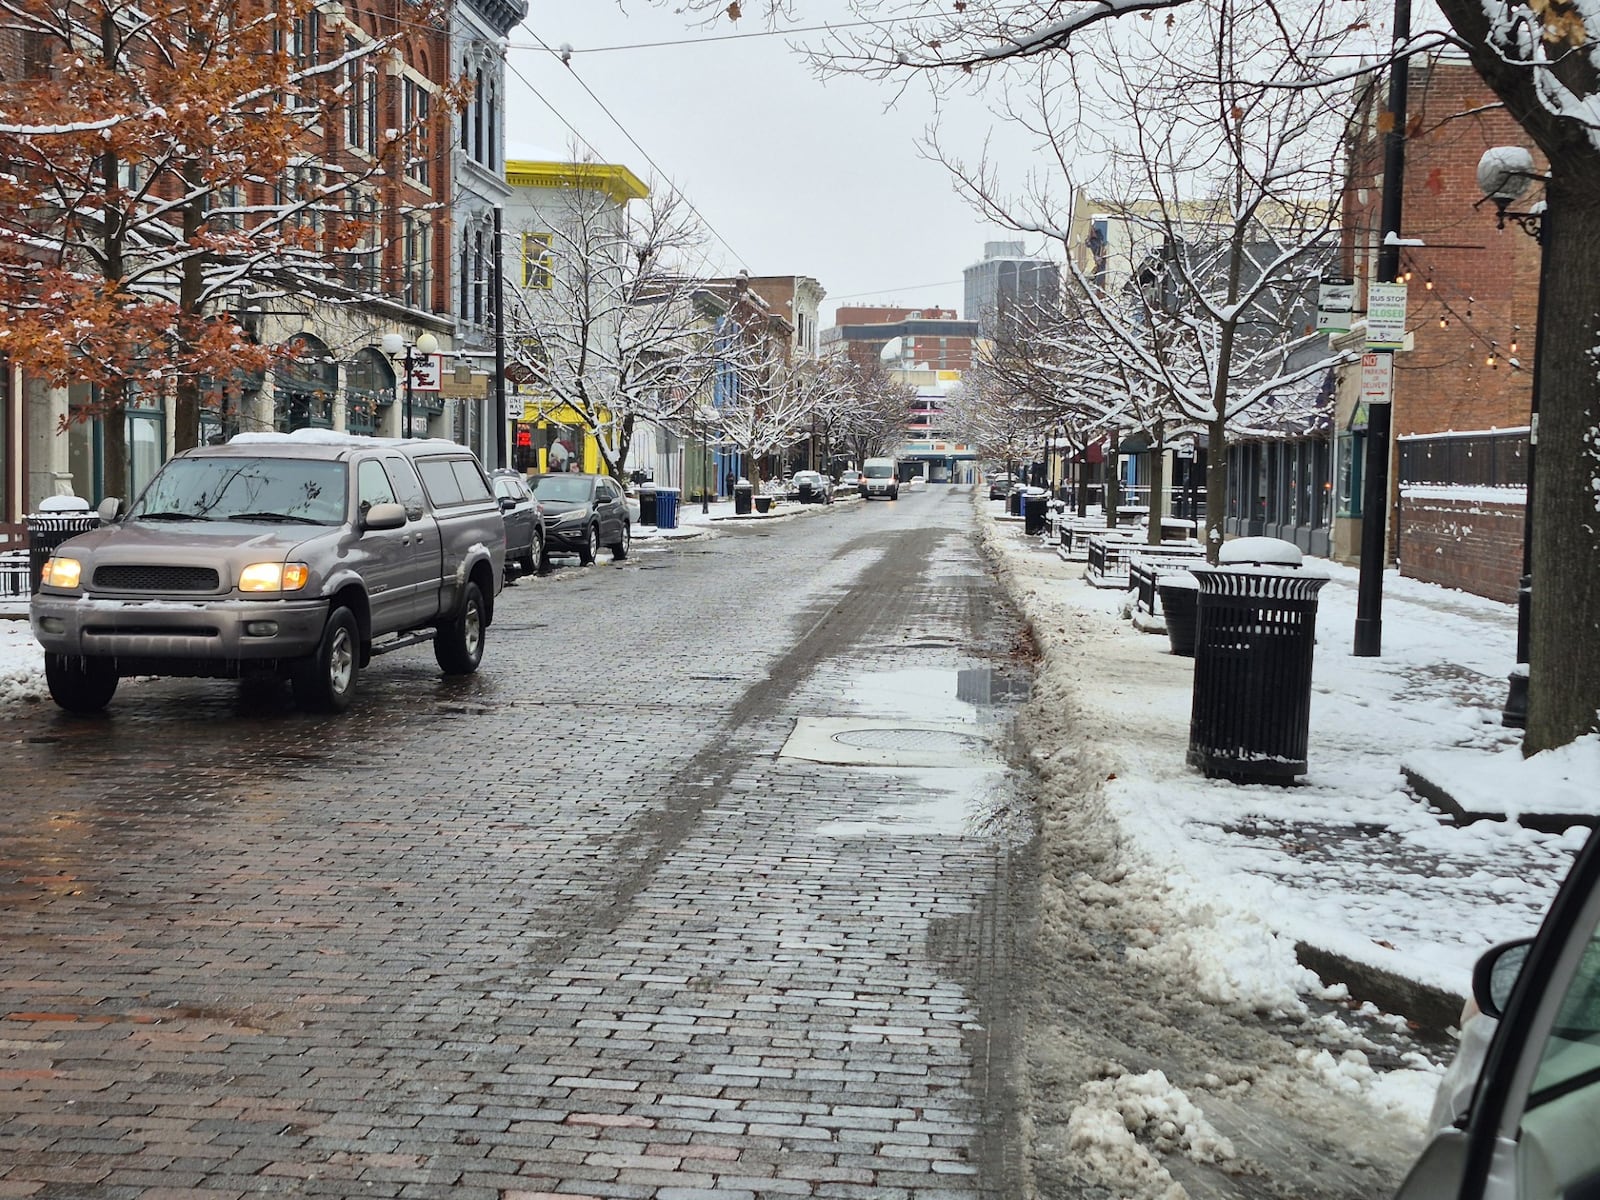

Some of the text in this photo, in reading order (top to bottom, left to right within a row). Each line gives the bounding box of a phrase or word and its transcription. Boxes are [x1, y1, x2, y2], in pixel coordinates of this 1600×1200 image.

[1386, 295, 1406, 303] STOP
[1369, 309, 1405, 318] CLOSED
[1363, 356, 1376, 365] NO
